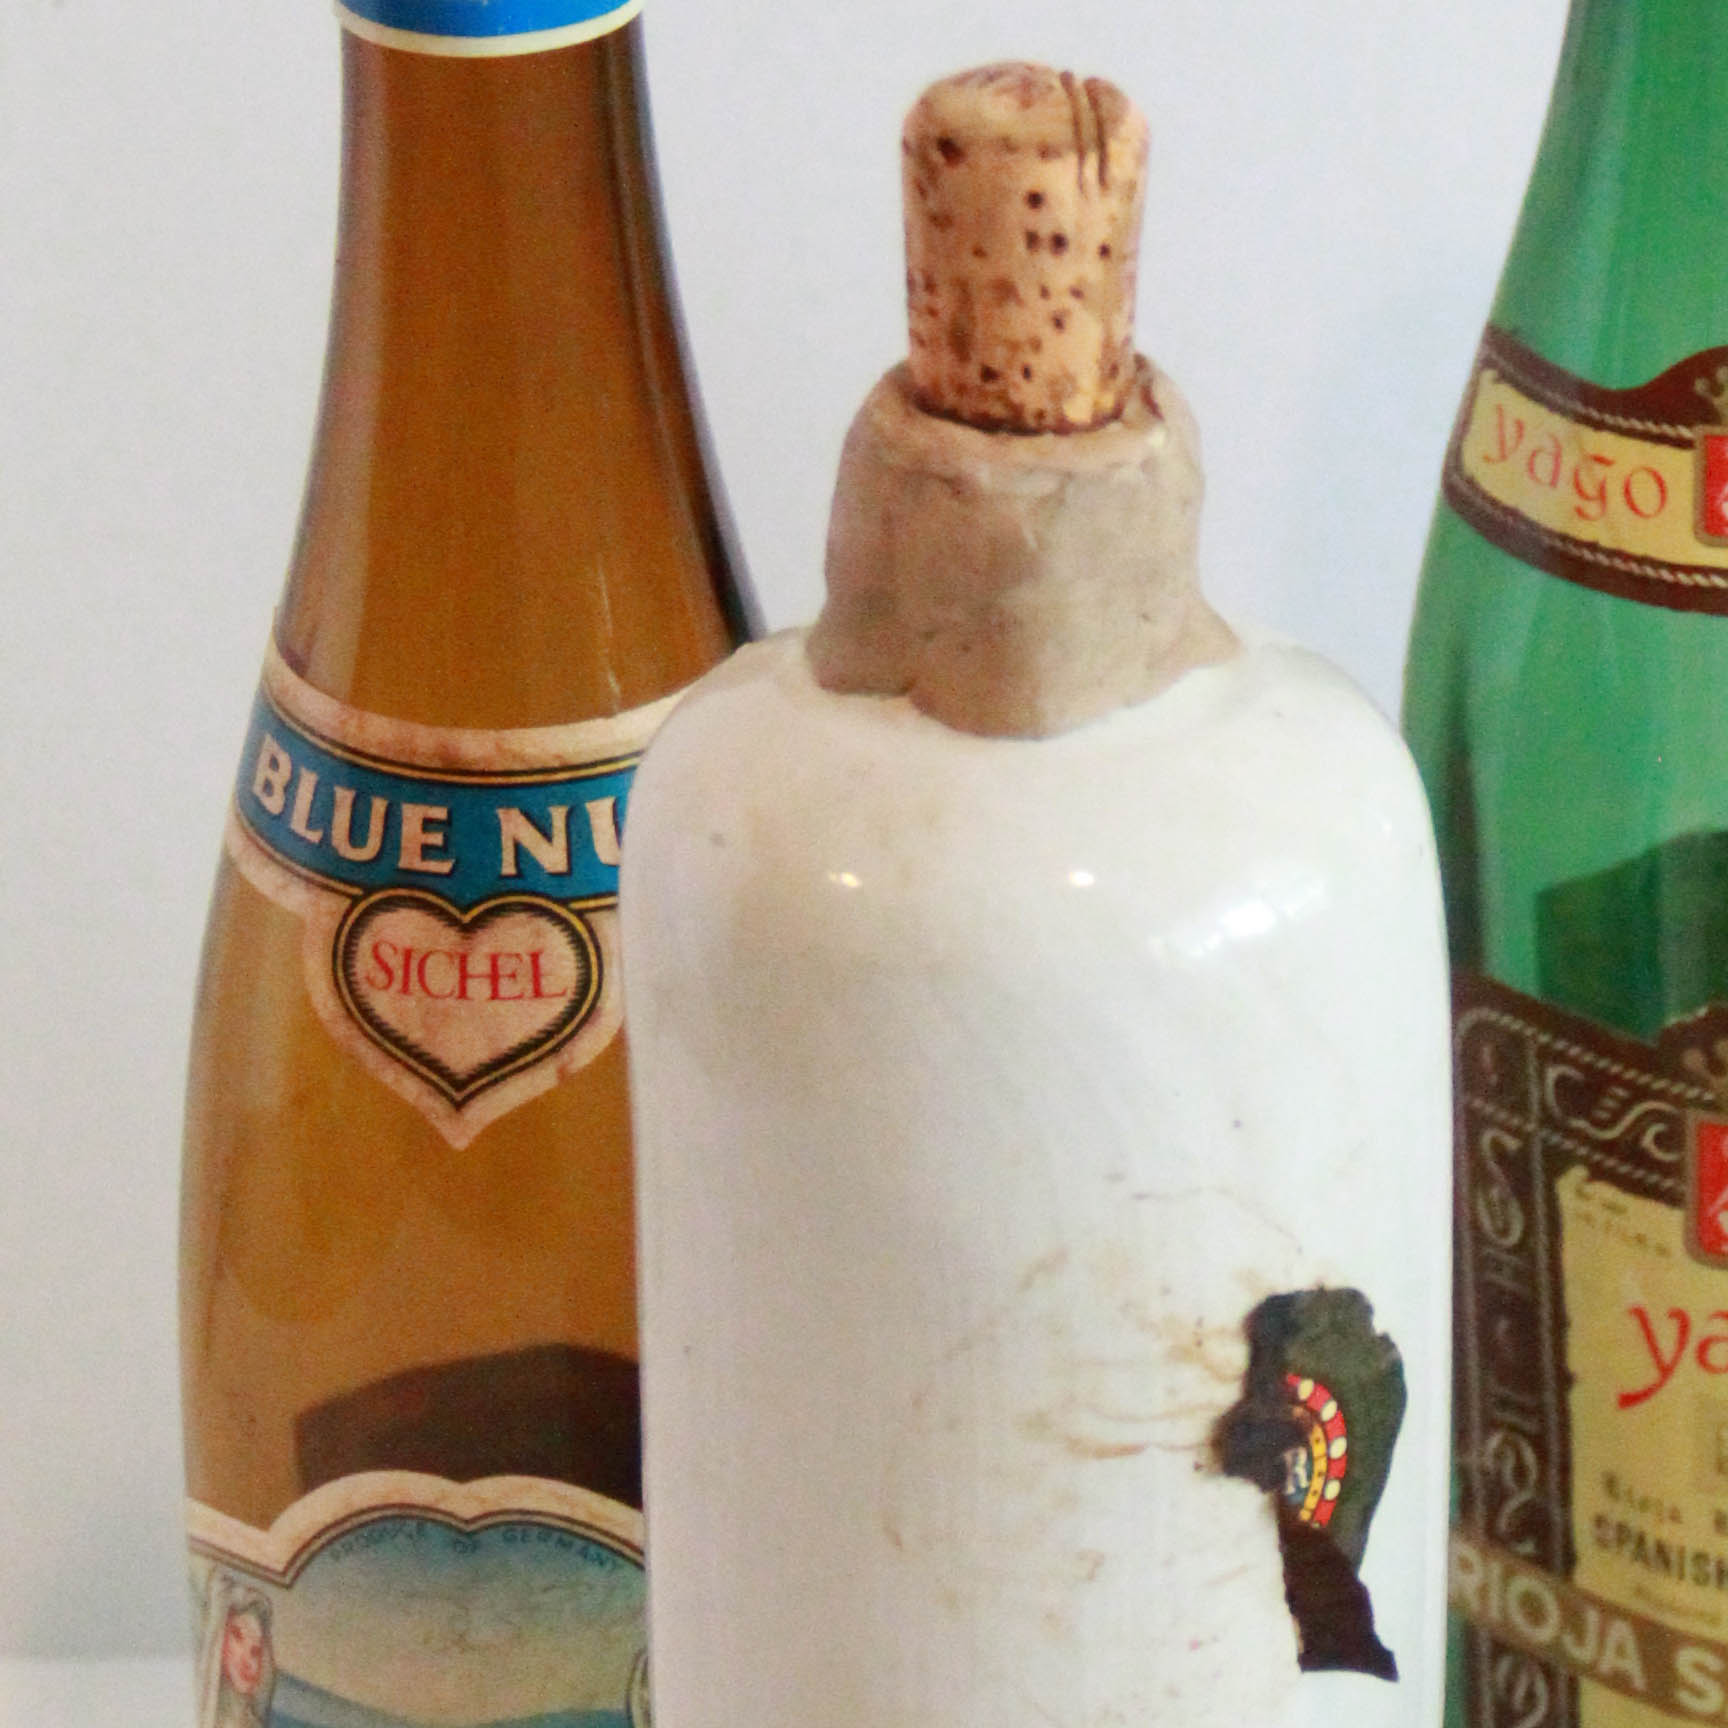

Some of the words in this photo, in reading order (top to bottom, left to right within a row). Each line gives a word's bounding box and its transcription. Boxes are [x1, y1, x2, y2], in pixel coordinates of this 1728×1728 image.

[1482, 404, 1668, 521] yago
[251, 733, 456, 876] BLUE
[364, 940, 568, 1002] SICHEL
